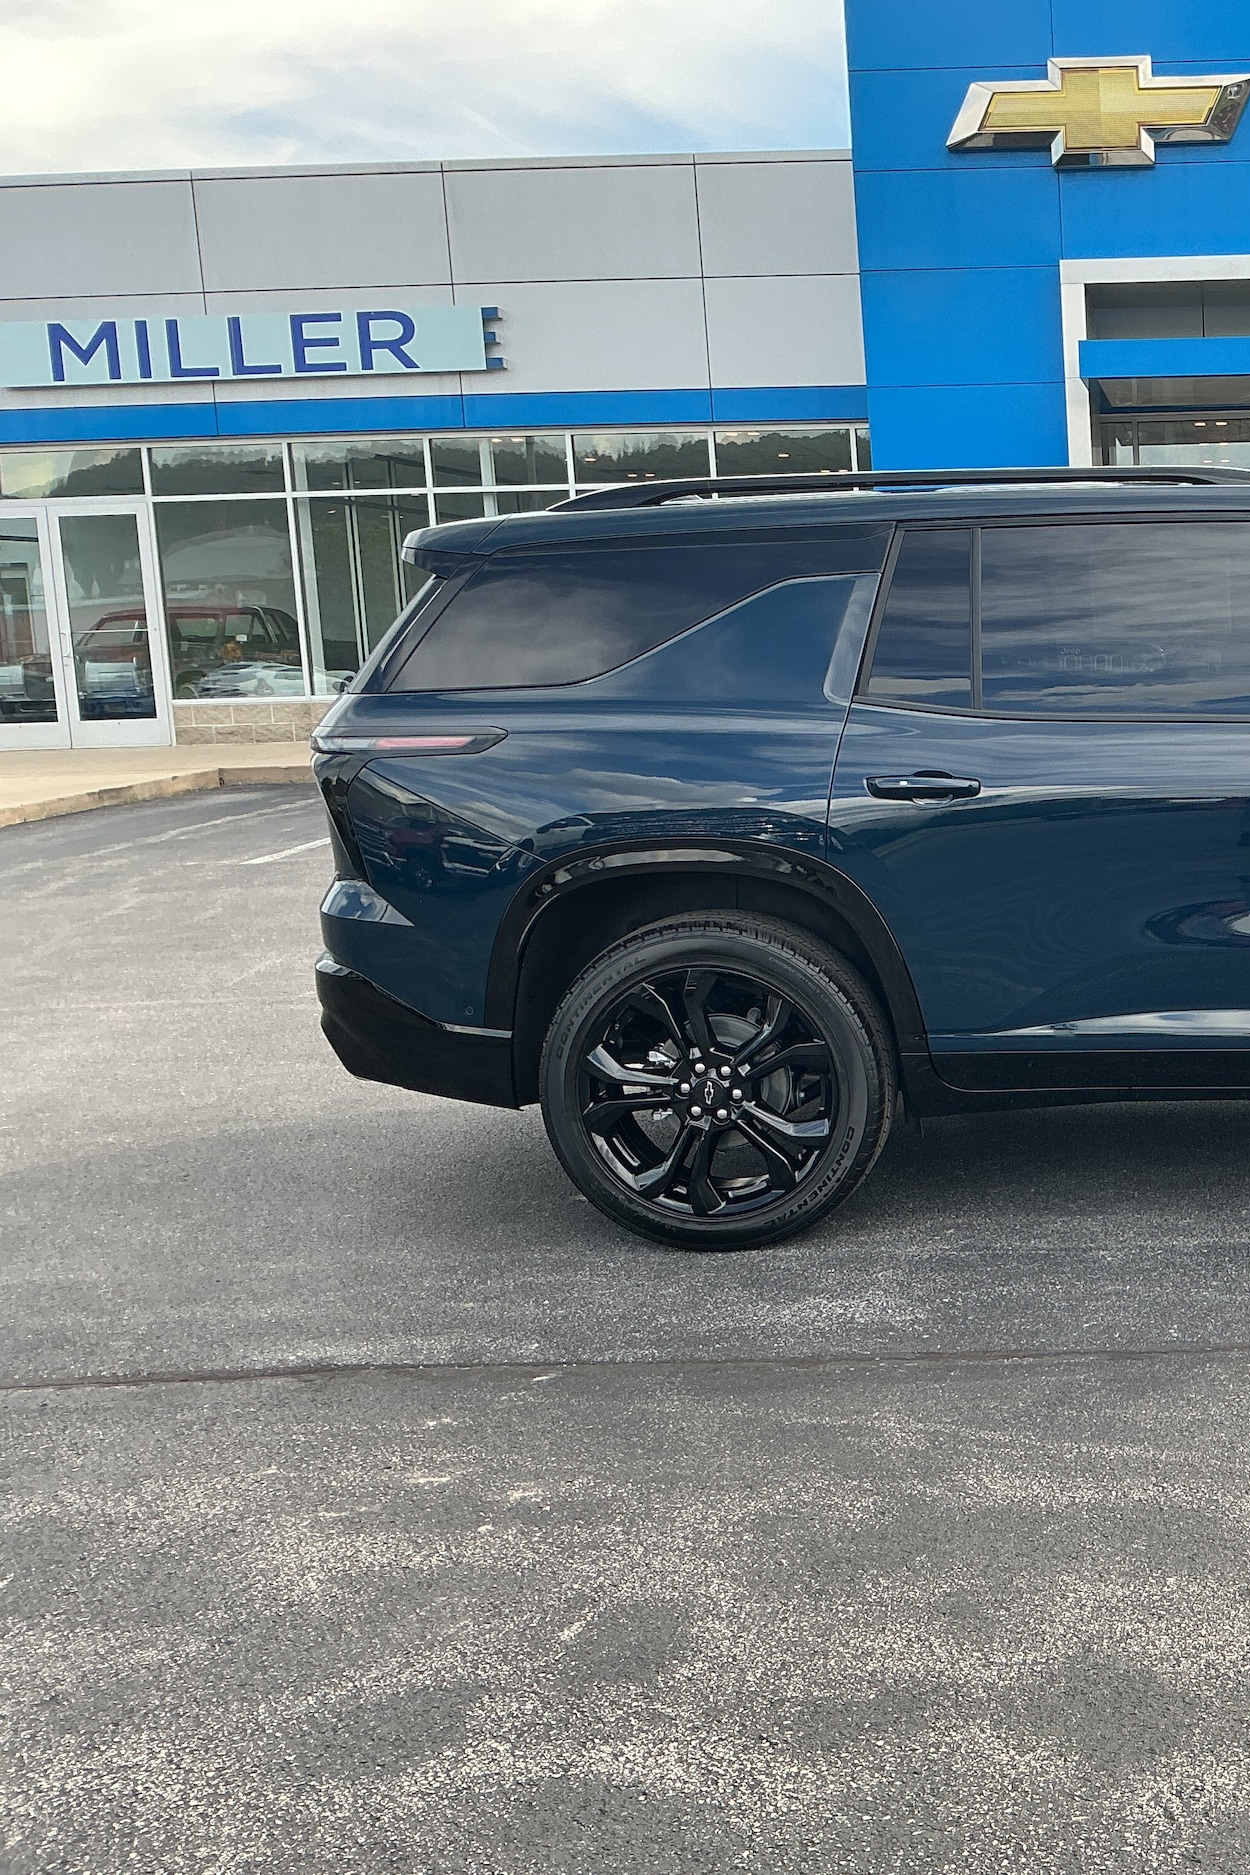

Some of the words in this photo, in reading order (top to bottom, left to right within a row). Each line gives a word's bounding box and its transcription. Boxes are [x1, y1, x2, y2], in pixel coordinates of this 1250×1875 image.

[47, 309, 420, 382] MILLER
[1060, 647, 1081, 655] Jeep
[556, 956, 647, 1060] CONTINENTAL
[764, 1125, 856, 1225] CONTINENTAL
